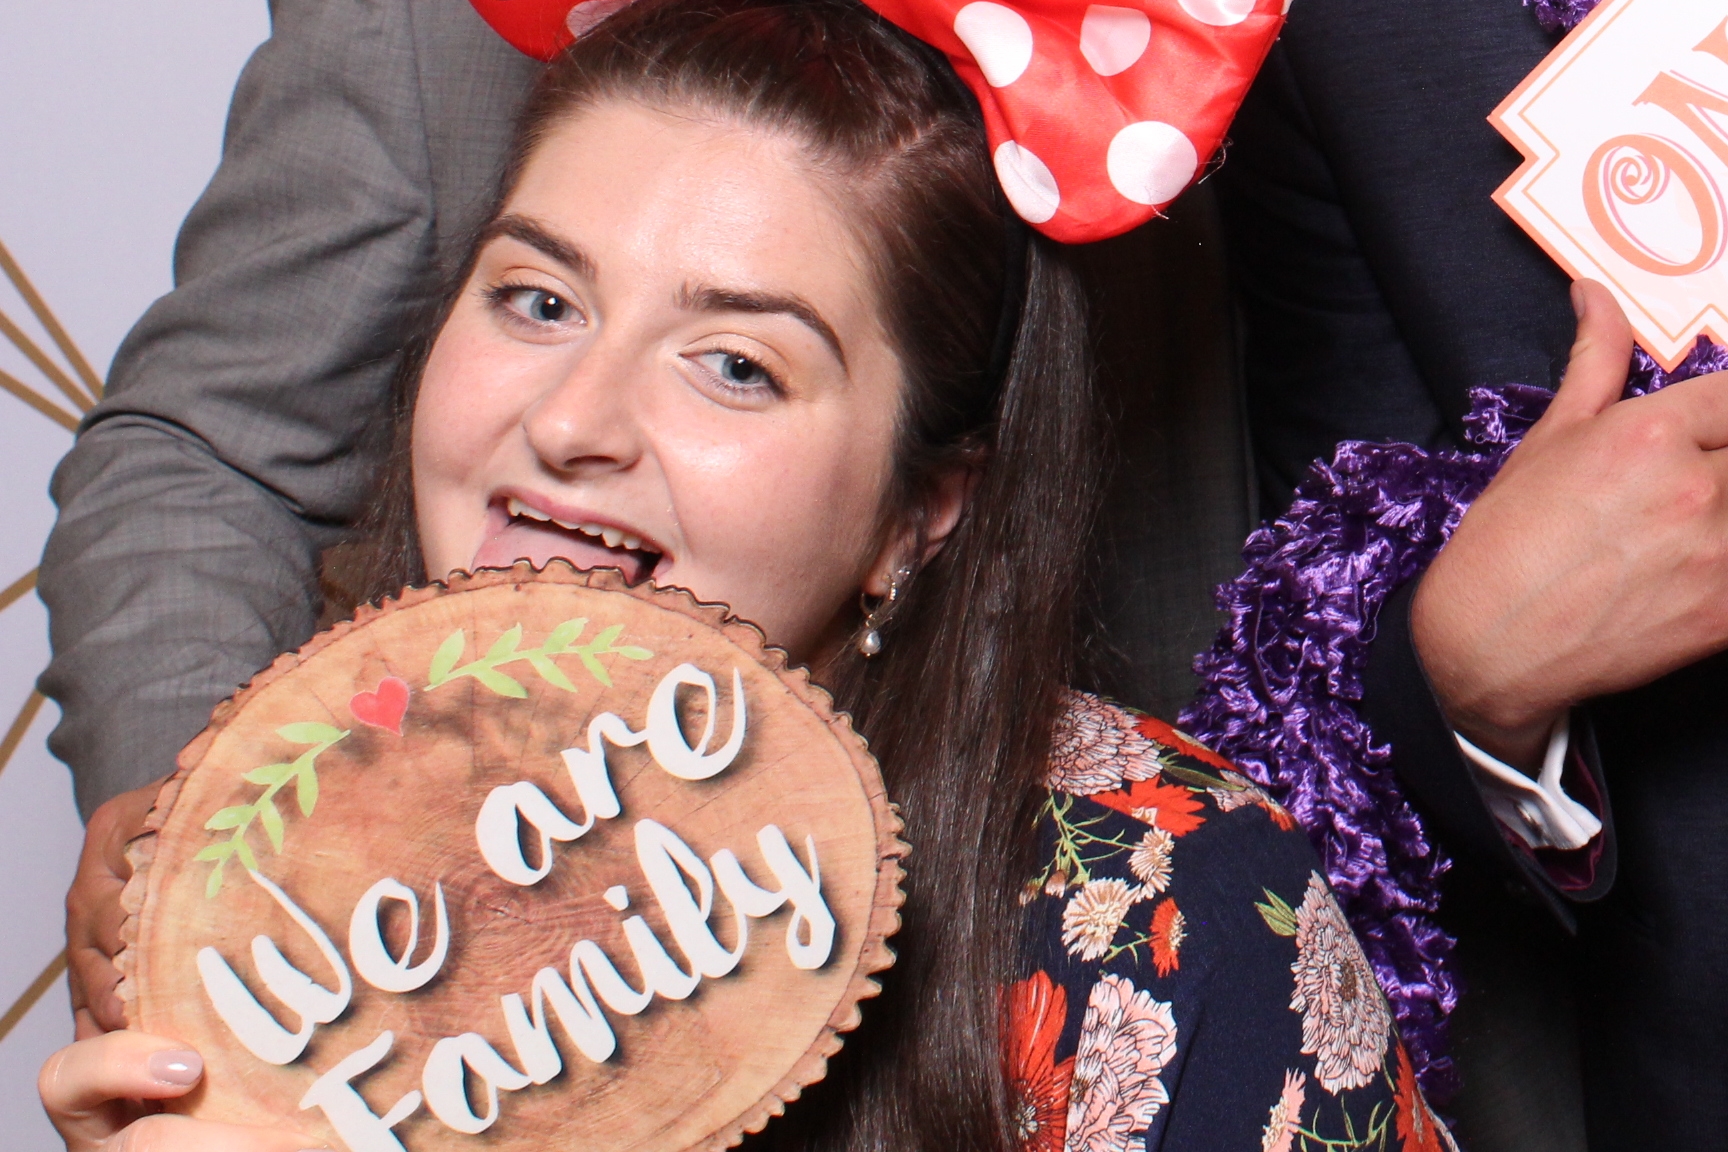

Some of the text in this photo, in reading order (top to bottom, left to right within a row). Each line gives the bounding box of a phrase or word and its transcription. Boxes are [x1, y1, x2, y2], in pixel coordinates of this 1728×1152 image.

[197, 663, 746, 1066] We are
[299, 817, 836, 1152] Family
